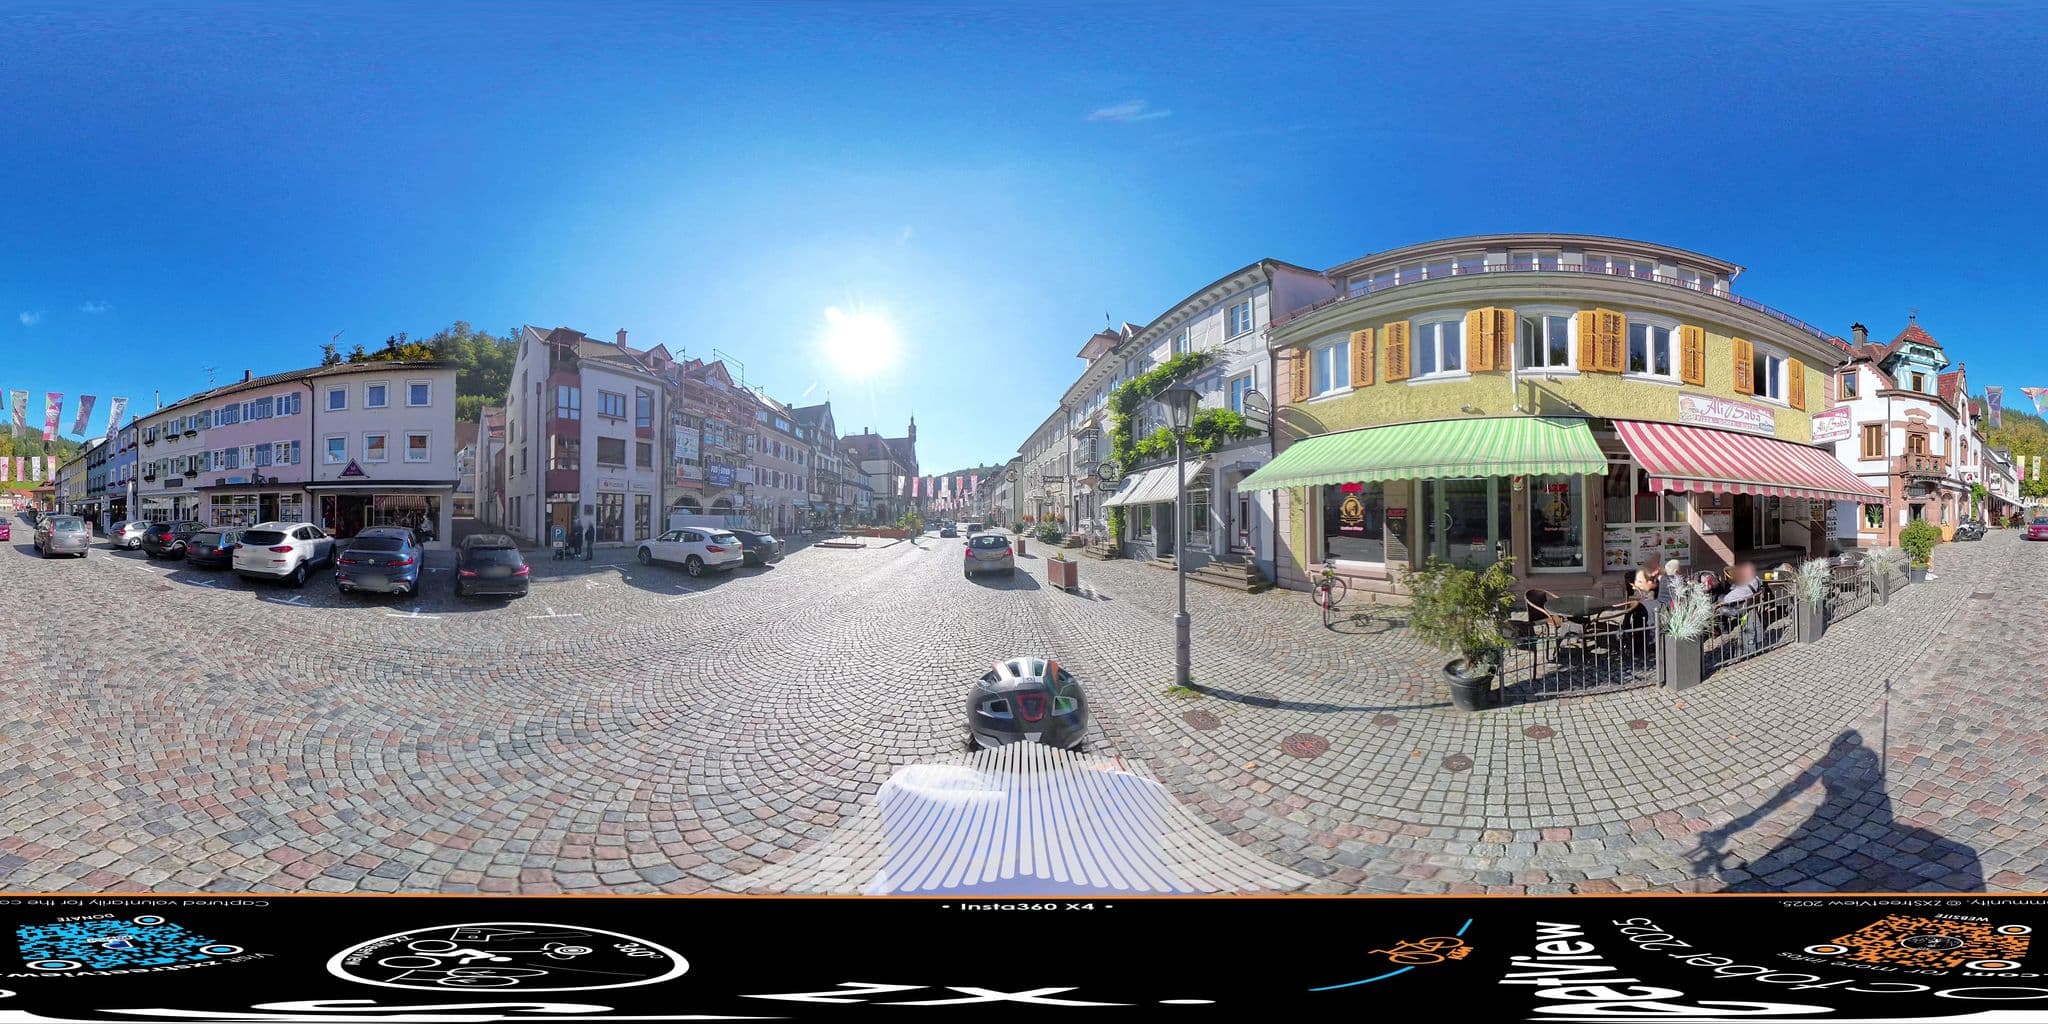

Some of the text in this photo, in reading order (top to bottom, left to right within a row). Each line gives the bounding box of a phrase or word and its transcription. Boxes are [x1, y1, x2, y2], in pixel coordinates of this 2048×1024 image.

[1700, 396, 1724, 416] Ali
[1725, 402, 1761, 421] Baba
[555, 528, 562, 537] P
